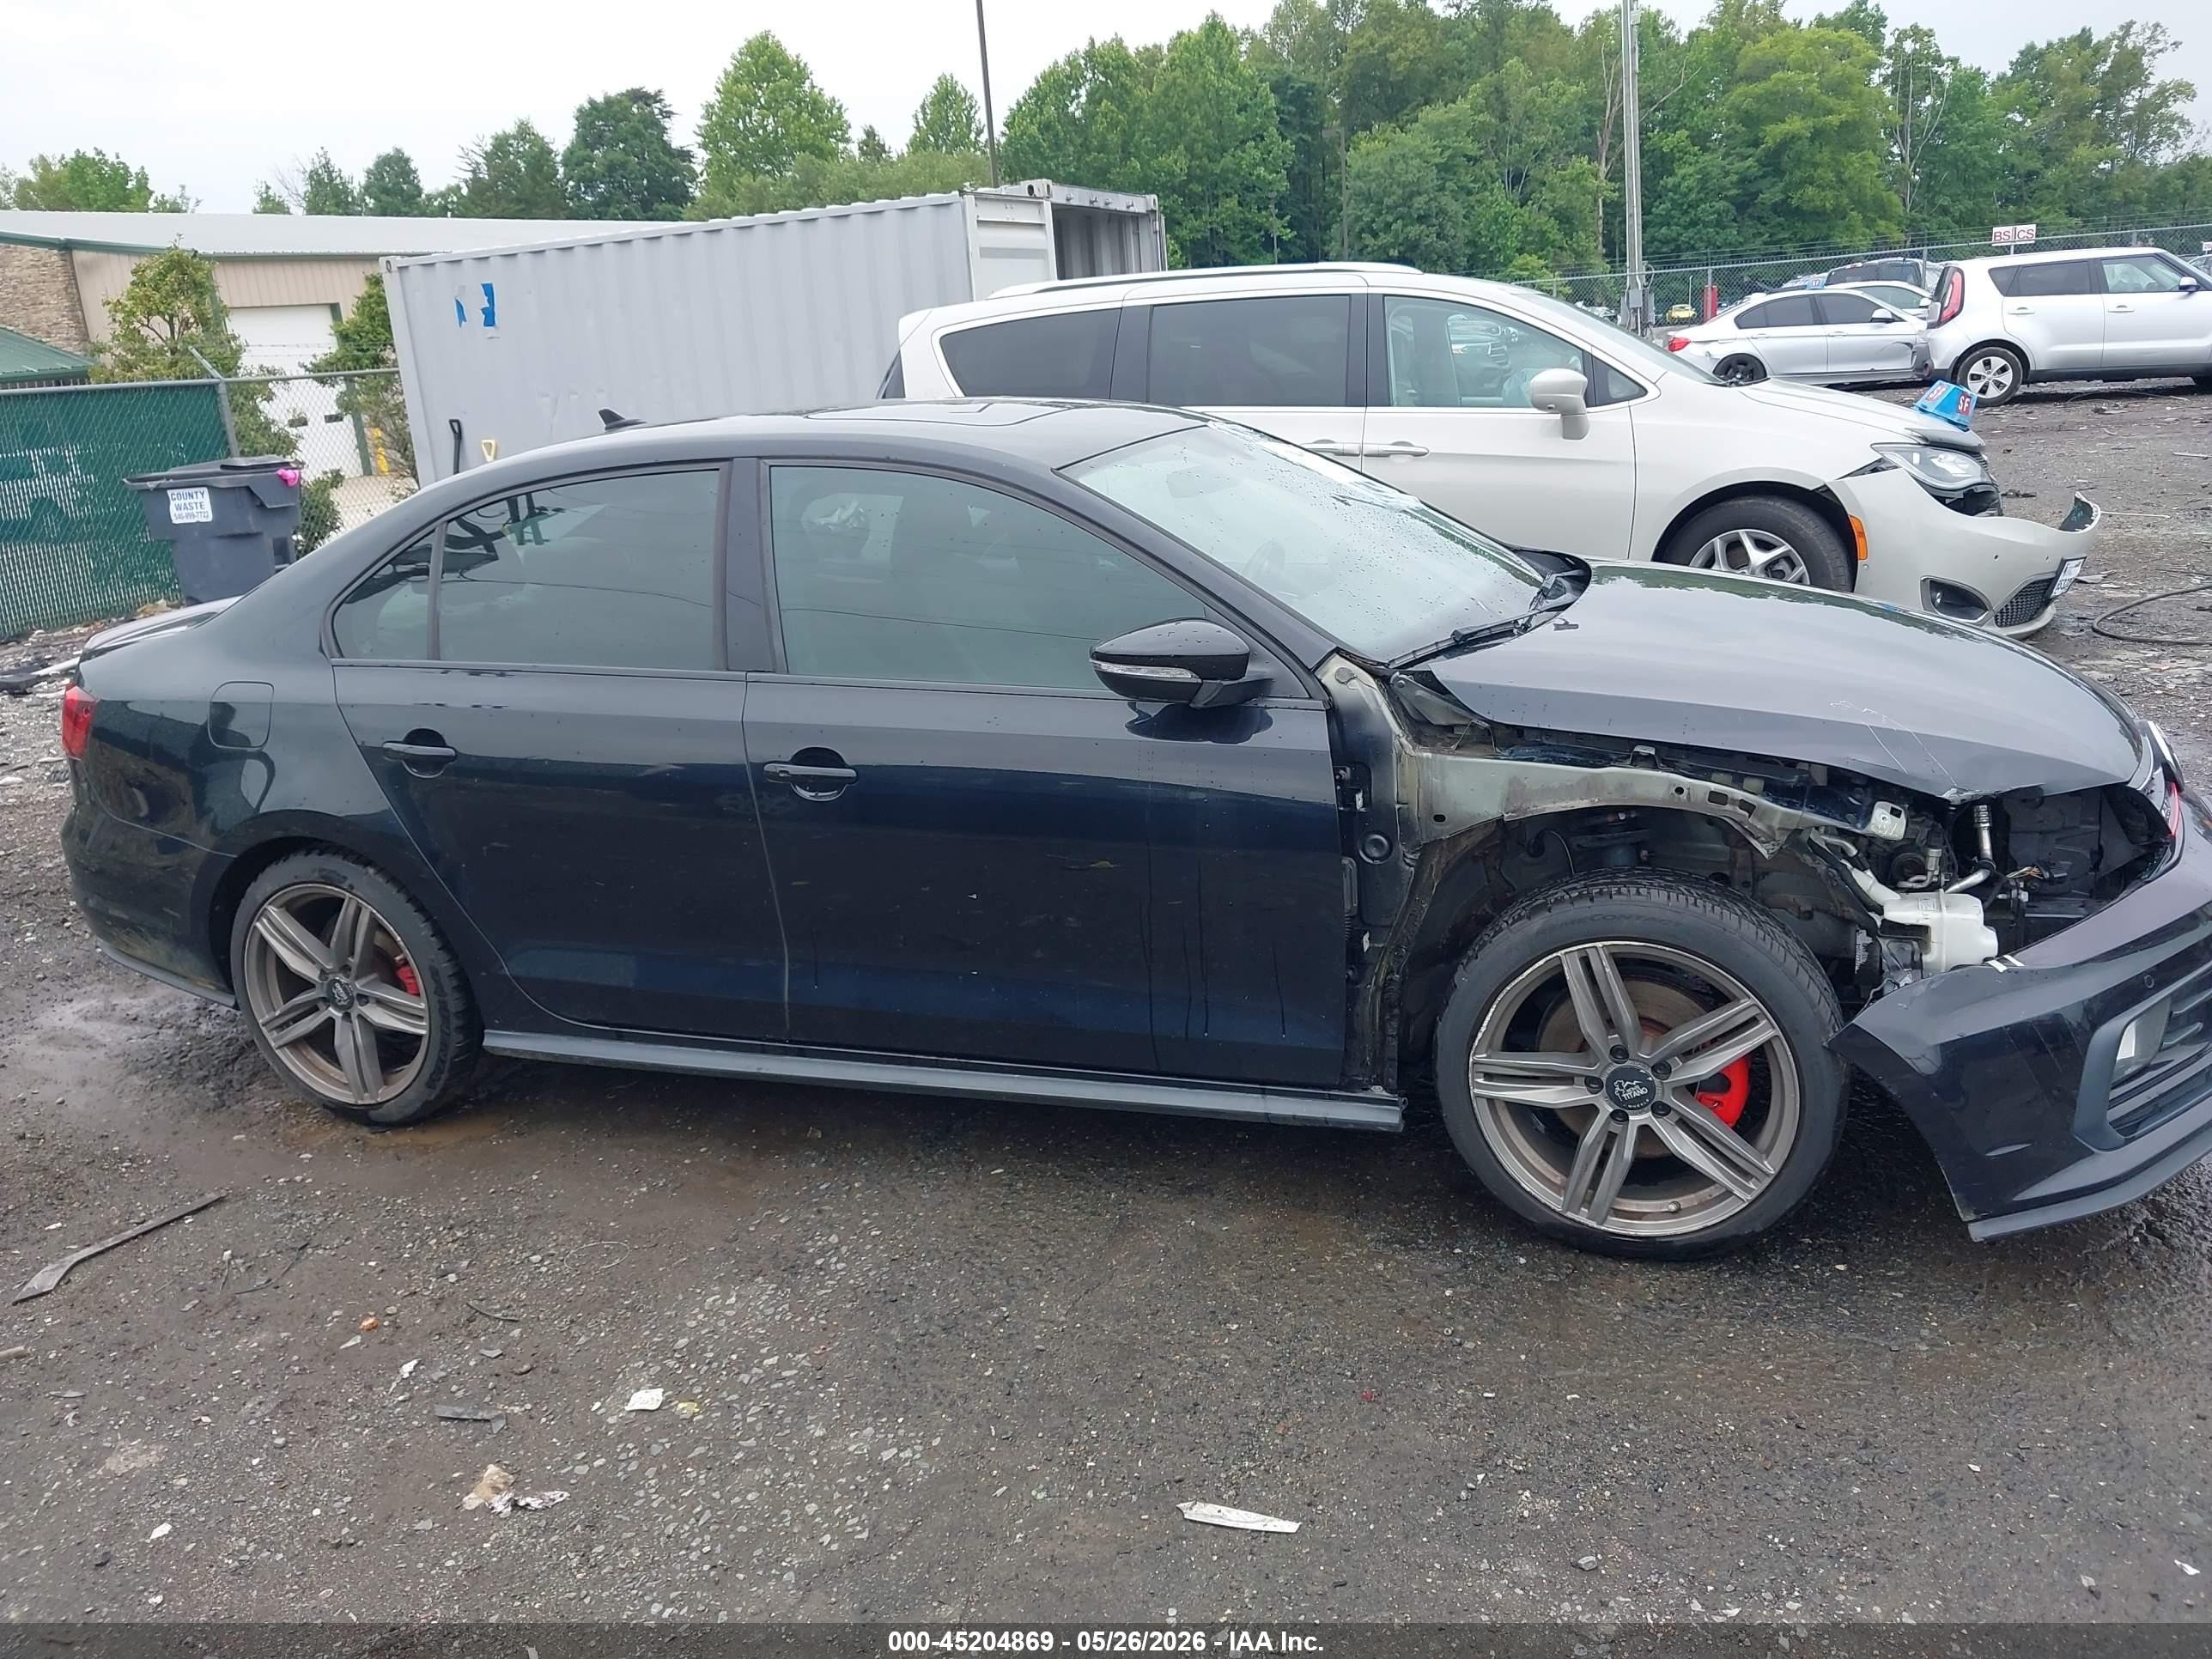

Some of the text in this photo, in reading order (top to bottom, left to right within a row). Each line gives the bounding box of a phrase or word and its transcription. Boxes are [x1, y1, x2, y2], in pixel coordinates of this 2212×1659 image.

[1958, 395, 1972, 412] SF
[170, 490, 205, 501] COUNTY
[174, 501, 206, 512] WASTE
[1621, 1086, 1649, 1101] TITANO
